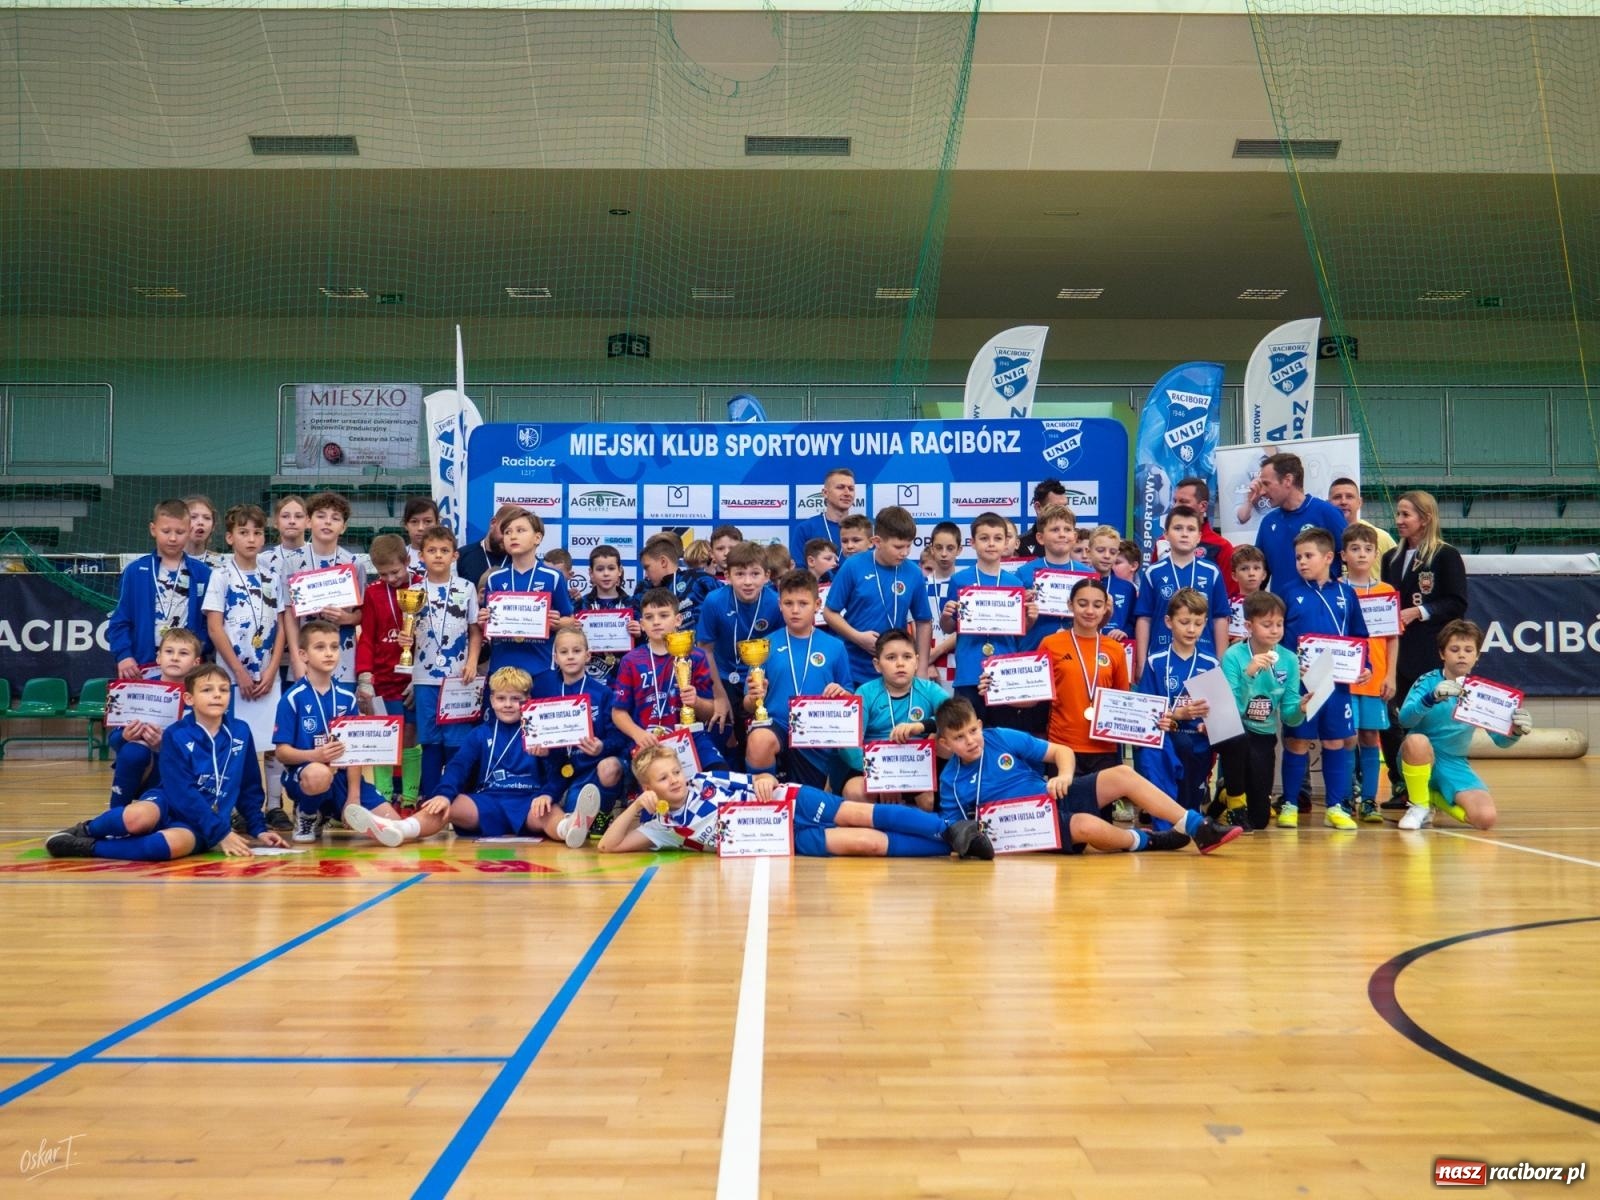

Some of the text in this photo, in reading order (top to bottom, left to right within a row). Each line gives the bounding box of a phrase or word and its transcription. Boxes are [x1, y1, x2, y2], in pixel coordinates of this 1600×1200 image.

[994, 367, 1025, 385] UNIA
[1271, 361, 1303, 381] UNIA
[310, 388, 407, 407] MIESZKO
[1172, 409, 1185, 418] 1946
[569, 425, 1021, 457] MIEJSKI KLUB SPORTOWY UNIA RACIBÓRZ
[1168, 421, 1204, 444] UNIA
[1045, 438, 1078, 458] UNIA
[501, 456, 556, 467] Racibórz
[1143, 472, 1156, 549] SPORTOWY
[571, 537, 600, 546] BOXY
[1479, 613, 1600, 653] ACIB
[737, 817, 754, 825] WINTER
[999, 814, 1017, 823] WINTER
